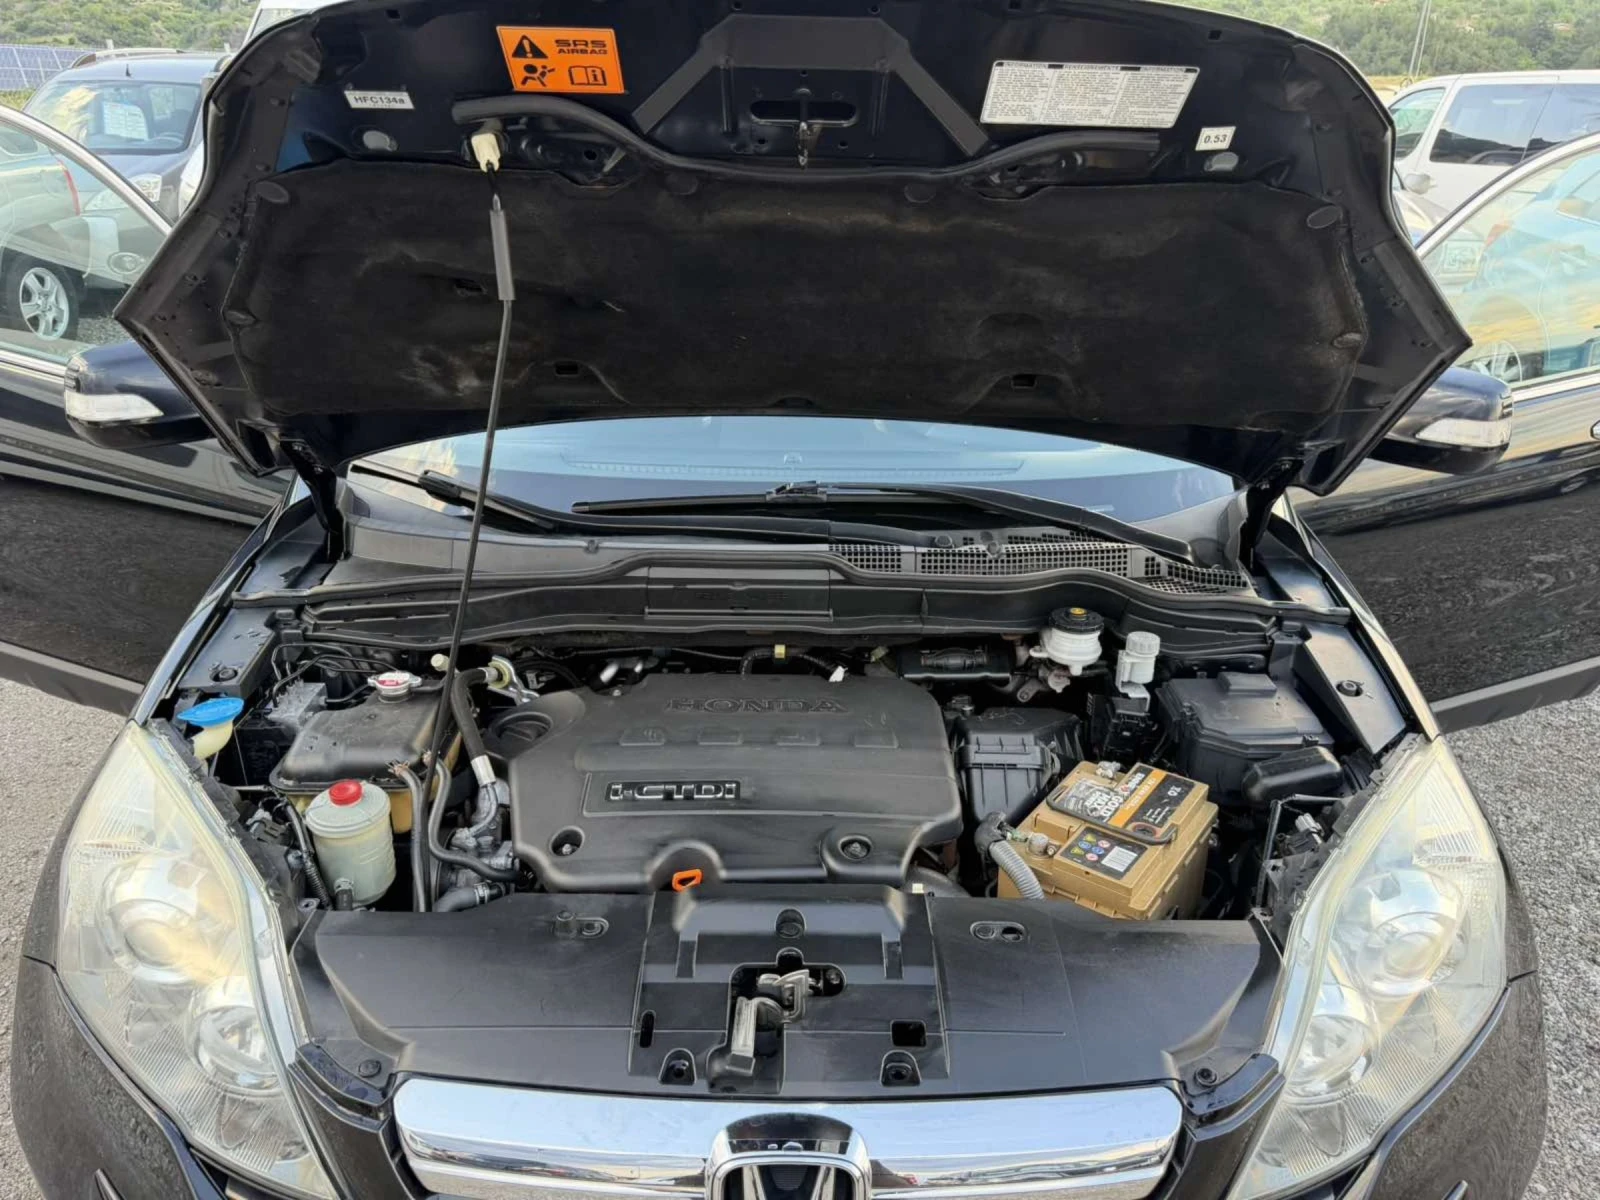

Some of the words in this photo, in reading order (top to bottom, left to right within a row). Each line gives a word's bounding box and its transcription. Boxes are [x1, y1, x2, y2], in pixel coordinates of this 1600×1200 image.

[554, 39, 607, 49] SRS
[353, 96, 406, 104] HFC134a
[1203, 134, 1228, 144] 0.53
[665, 699, 849, 713] HONDA
[1099, 795, 1124, 818] GOLD
